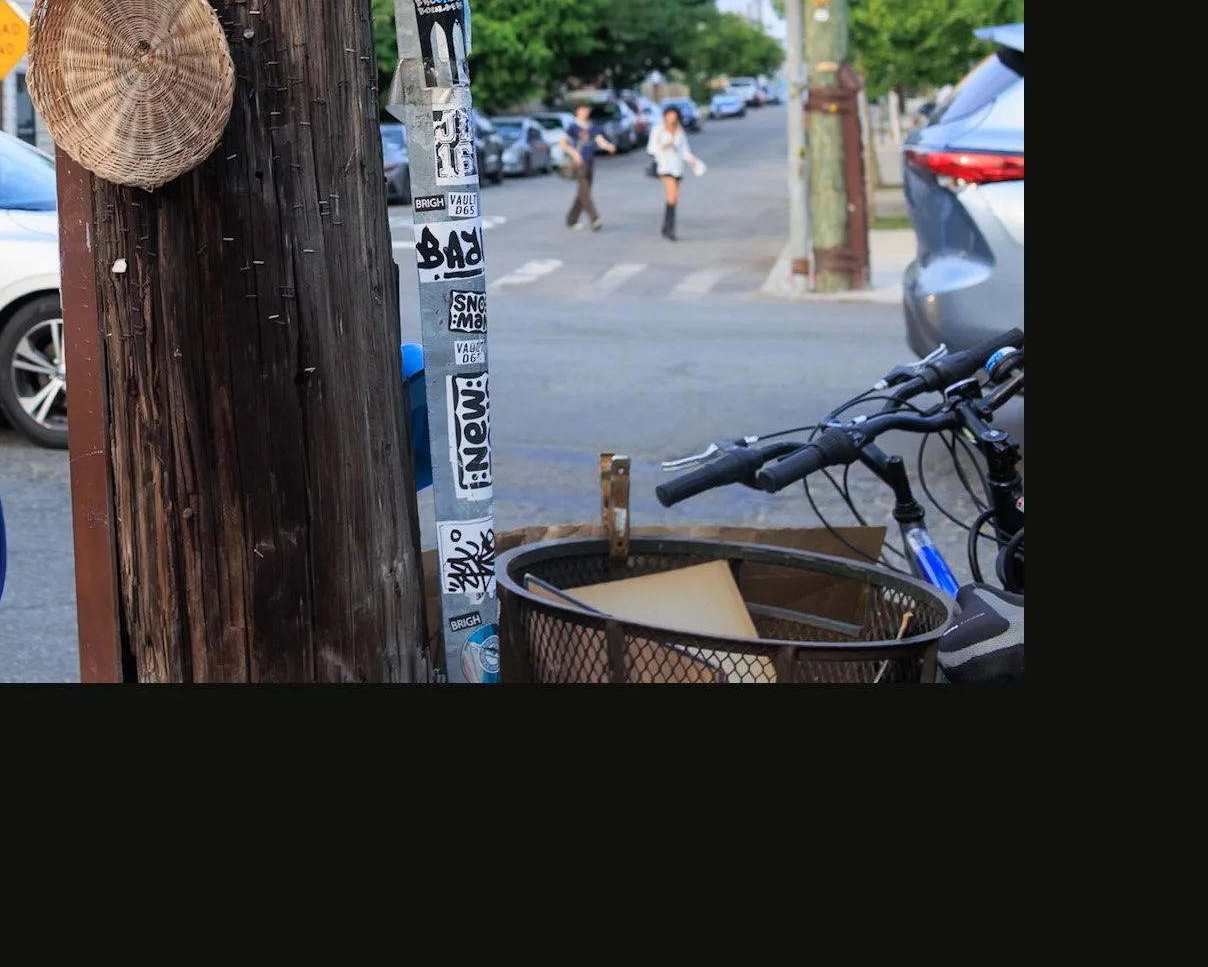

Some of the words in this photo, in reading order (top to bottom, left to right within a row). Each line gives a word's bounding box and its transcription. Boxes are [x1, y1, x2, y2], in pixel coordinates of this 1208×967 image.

[415, 198, 444, 209] BRIGH
[450, 194, 477, 205] VAULT
[455, 205, 475, 215] D65
[450, 614, 481, 631] BRIGH
